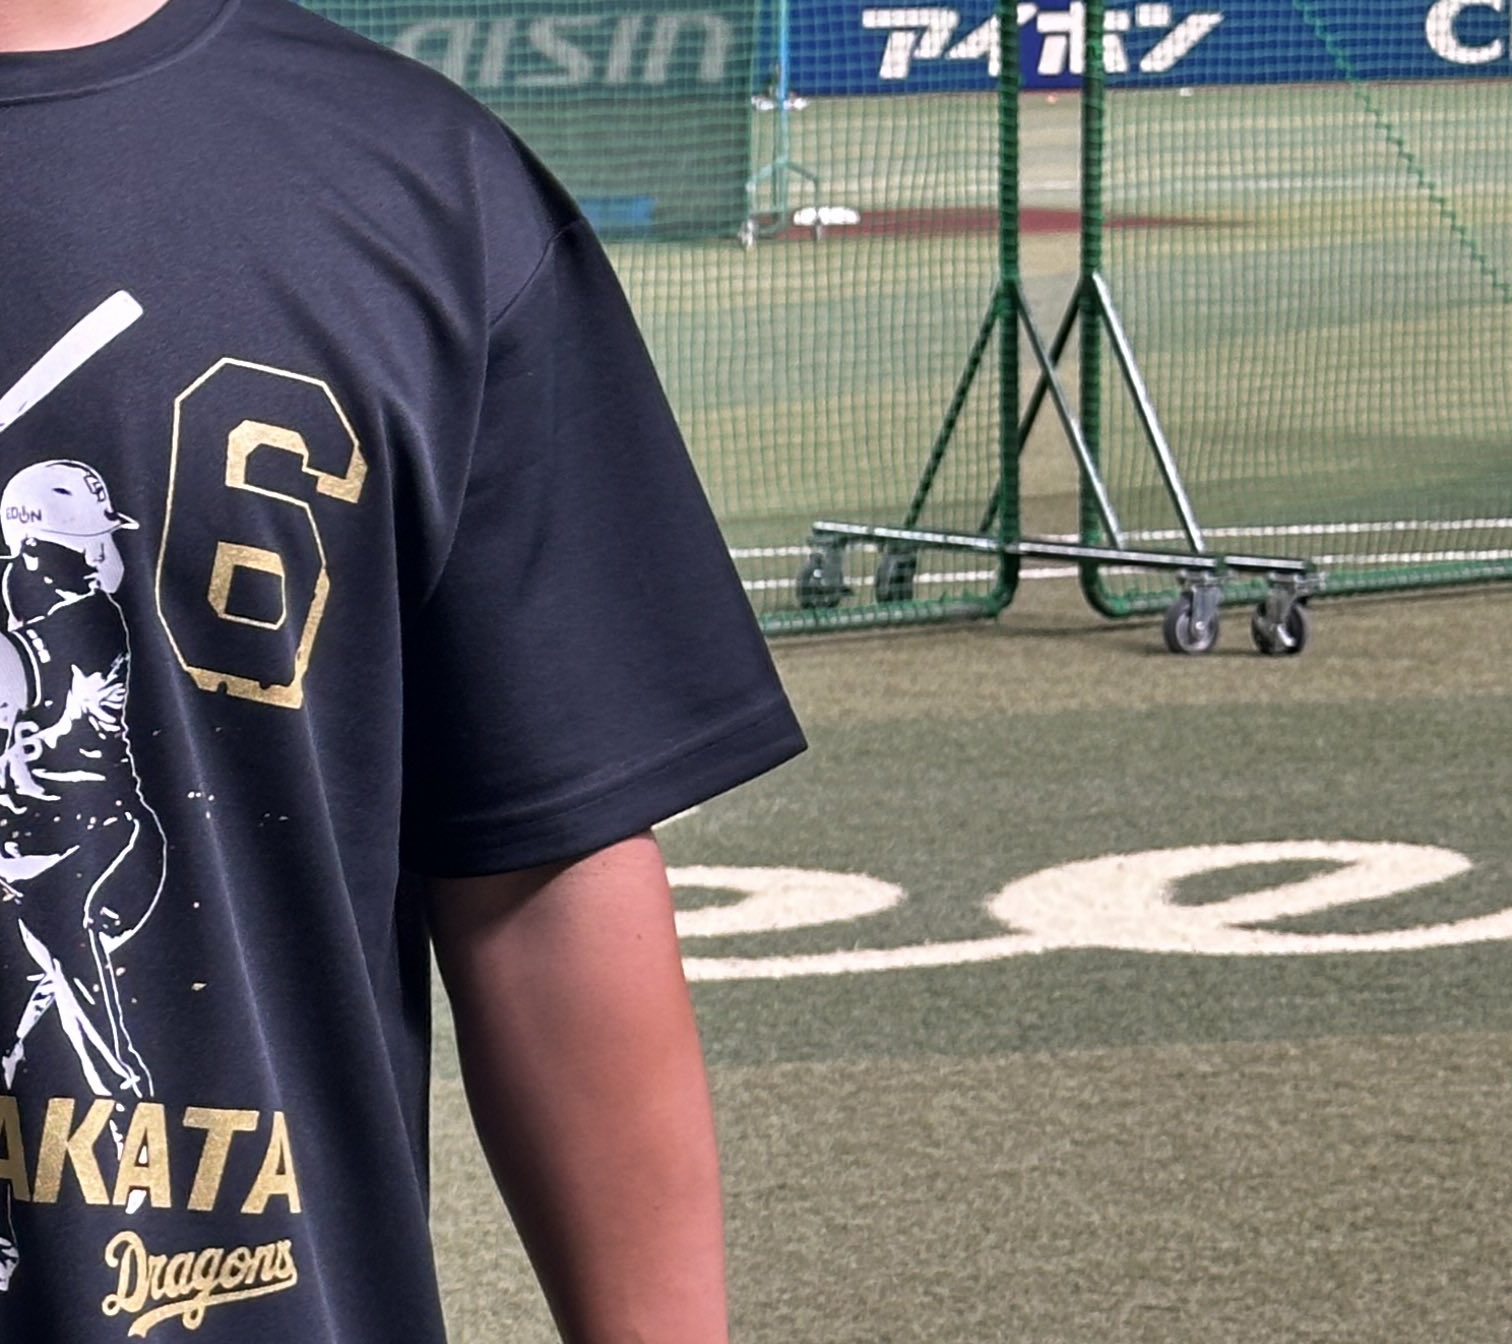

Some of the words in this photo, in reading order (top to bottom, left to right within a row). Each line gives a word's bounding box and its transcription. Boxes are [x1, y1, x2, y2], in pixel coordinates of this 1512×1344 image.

[861, 0, 1225, 80] アイホン
[155, 356, 369, 711] 6
[101, 1230, 299, 1338] Dragons
